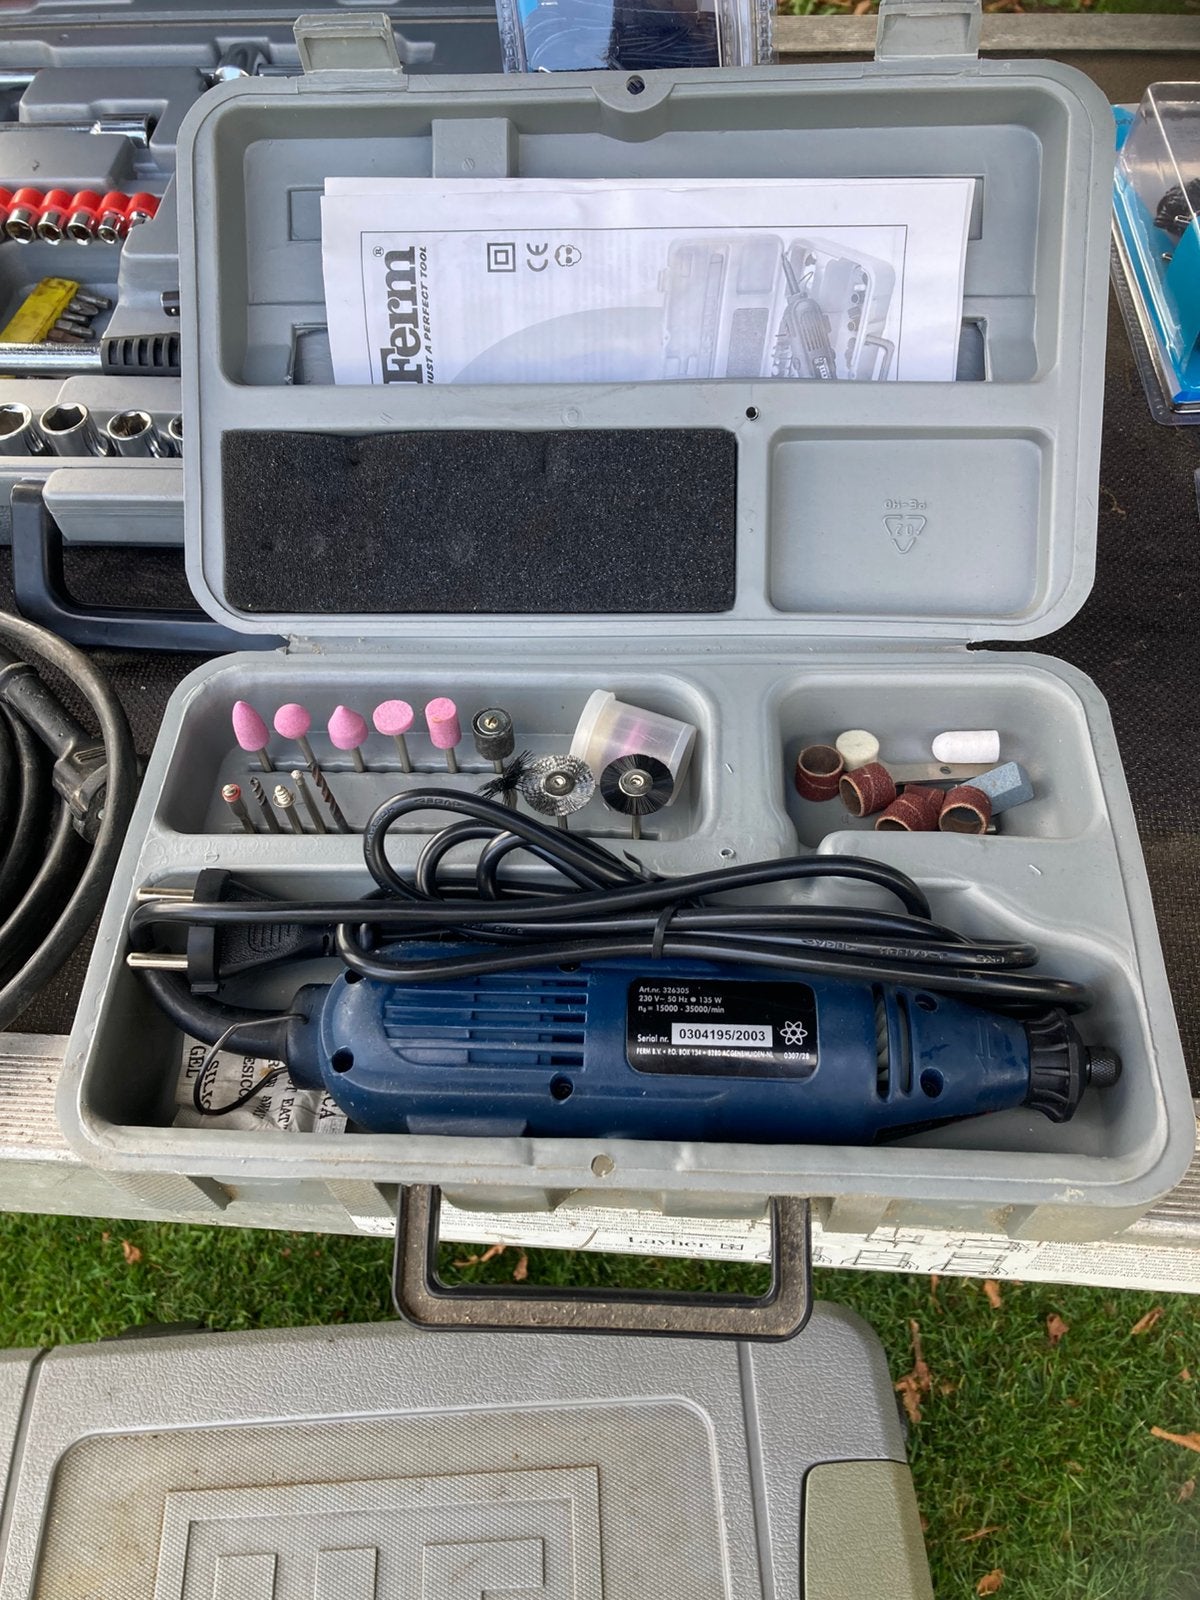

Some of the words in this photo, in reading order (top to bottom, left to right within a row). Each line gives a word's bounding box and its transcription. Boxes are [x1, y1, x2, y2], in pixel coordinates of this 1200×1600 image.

[419, 246, 428, 278] TOOL
[380, 246, 424, 384] Ferm
[420, 281, 431, 341] PERFECT
[685, 1005, 725, 1013] 35000/min
[637, 1034, 658, 1043] Serial
[679, 1028, 766, 1041] 0304195/2003
[186, 1045, 207, 1078] GEL
